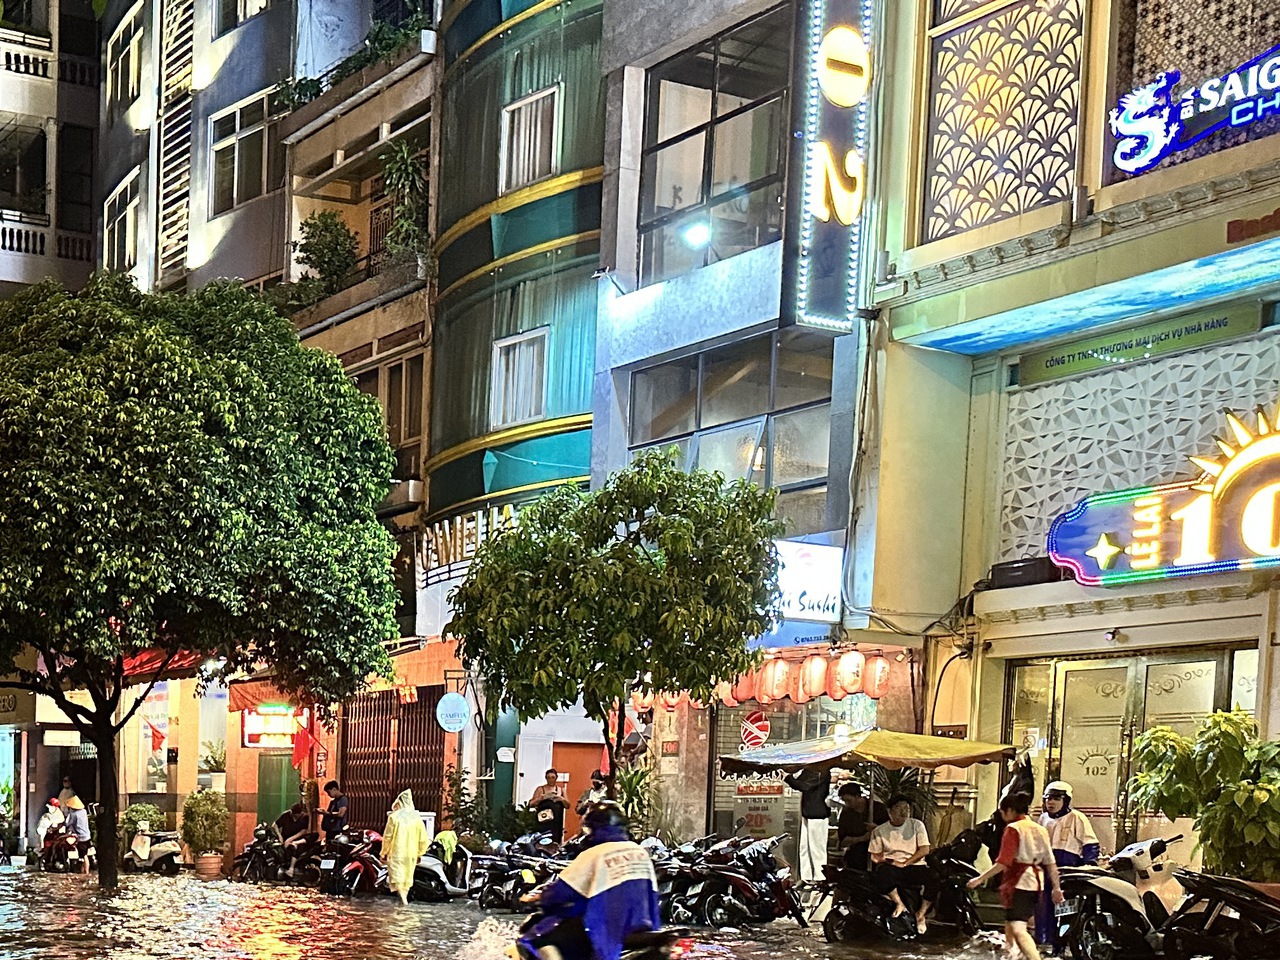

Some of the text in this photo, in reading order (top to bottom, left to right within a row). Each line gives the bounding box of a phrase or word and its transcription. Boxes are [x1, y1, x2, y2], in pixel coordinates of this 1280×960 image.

[1045, 354, 1066, 369] CÔNG
[1067, 353, 1076, 364] TY
[1171, 327, 1184, 341] VỤ
[1184, 321, 1203, 336] NHÀ
[1204, 316, 1229, 331] HÀNG
[1131, 496, 1163, 538] LAI
[798, 590, 837, 614] Sushi
[1085, 765, 1108, 777] 102
